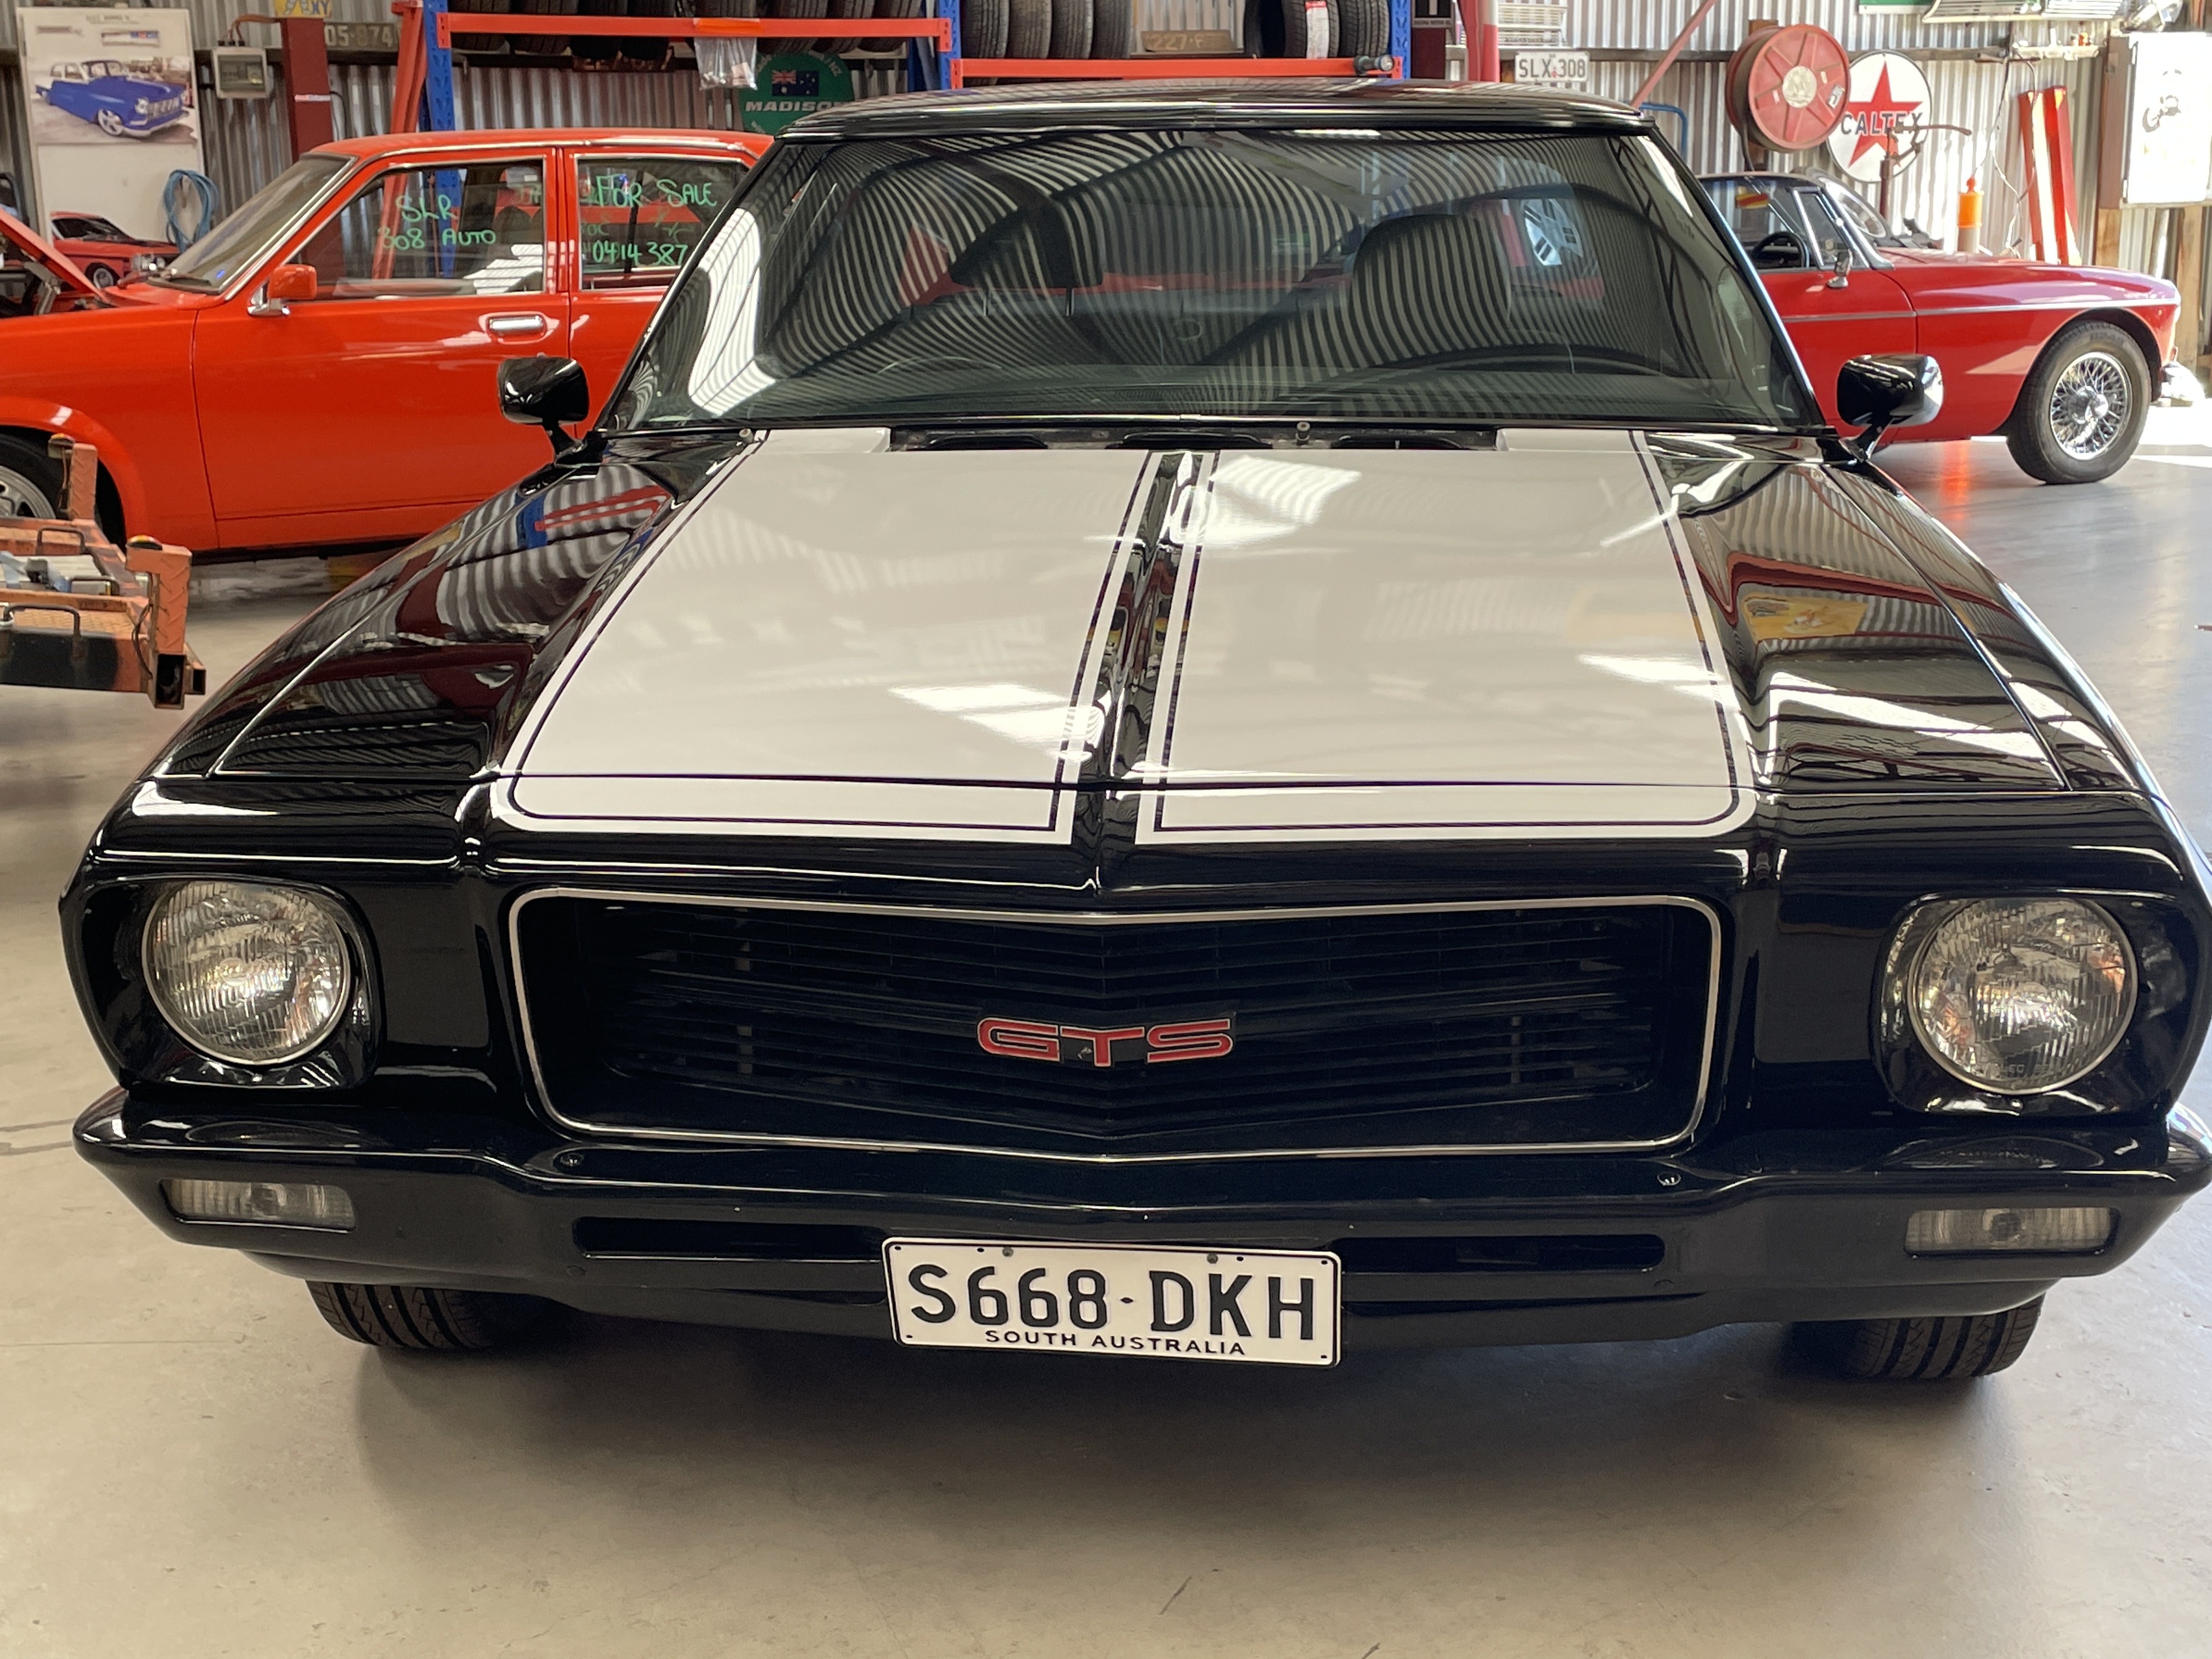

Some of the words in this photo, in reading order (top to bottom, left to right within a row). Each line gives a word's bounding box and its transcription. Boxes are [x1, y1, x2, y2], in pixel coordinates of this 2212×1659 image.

[596, 173, 642, 207] FOR
[656, 179, 716, 207] SALE
[396, 194, 458, 222] SLR
[378, 225, 425, 250] 308
[442, 228, 496, 245] AUTO
[978, 1018, 1233, 1067] GTS
[986, 1330, 1077, 1346] SOUTH
[1091, 1335, 1245, 1355] AUSTRALIA
